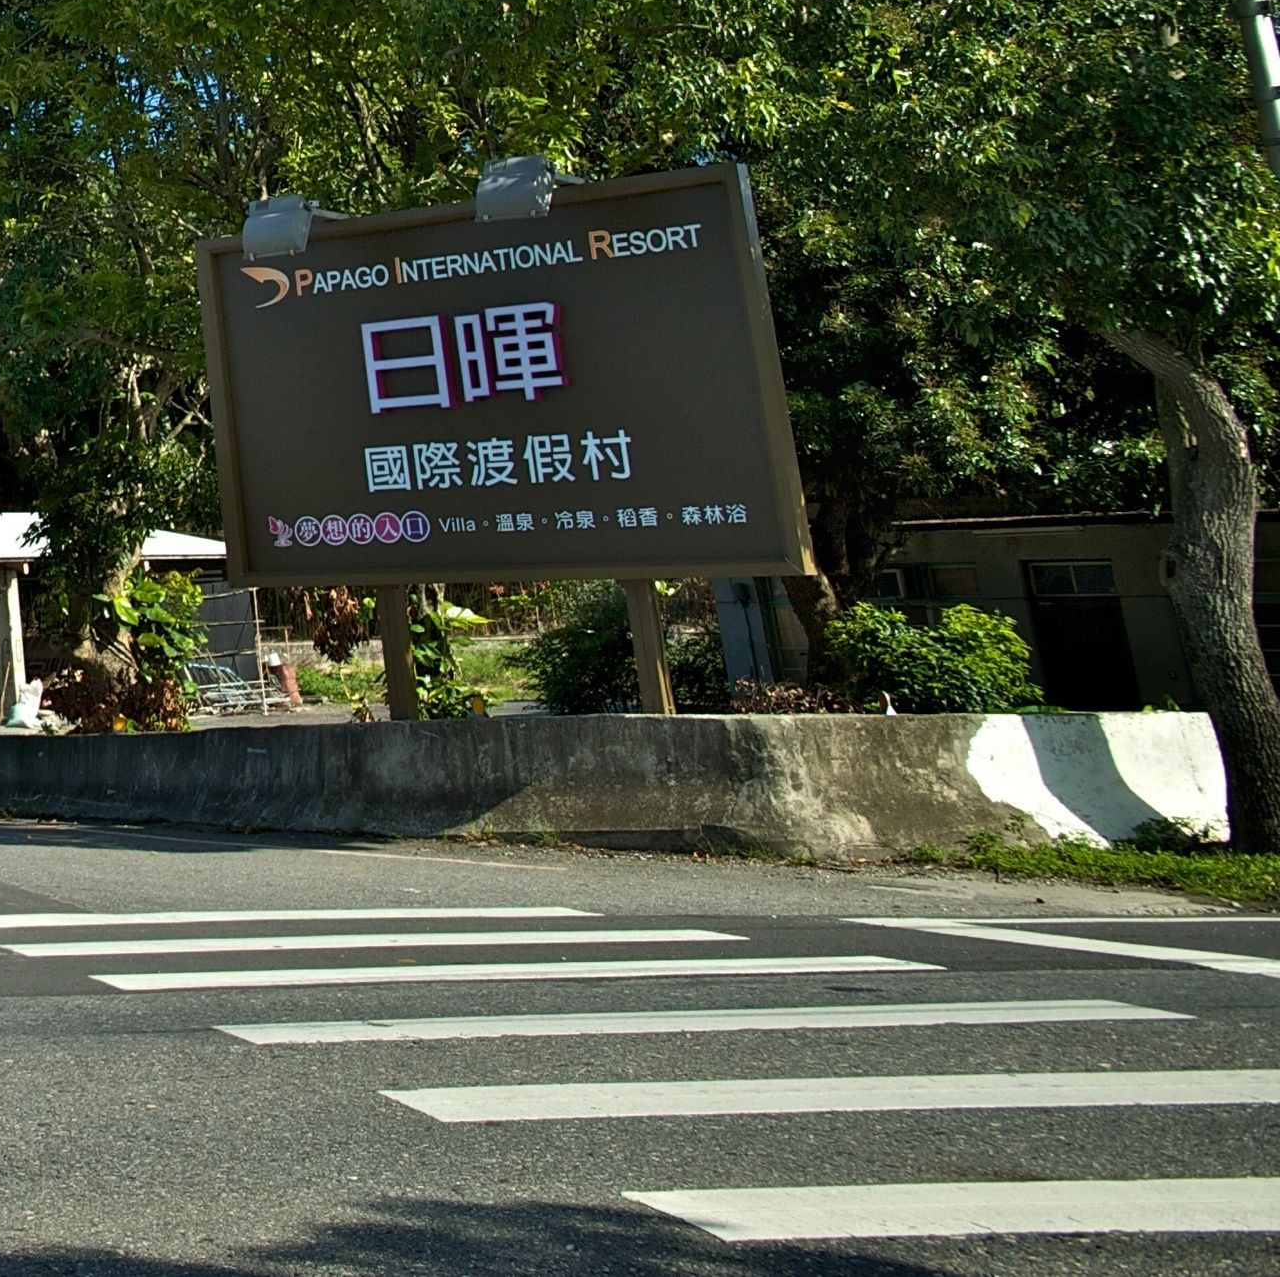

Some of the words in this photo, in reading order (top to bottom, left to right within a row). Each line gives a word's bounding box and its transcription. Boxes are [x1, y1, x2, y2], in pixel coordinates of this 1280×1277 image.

[294, 264, 389, 297] PAPAGO
[394, 240, 584, 284] INTERNATIONAL
[588, 224, 702, 260] RESORT
[361, 301, 567, 414] 日暉
[364, 429, 632, 493] 國際渡假村
[297, 513, 427, 545] 夢想的入口
[438, 517, 477, 533] Villa
